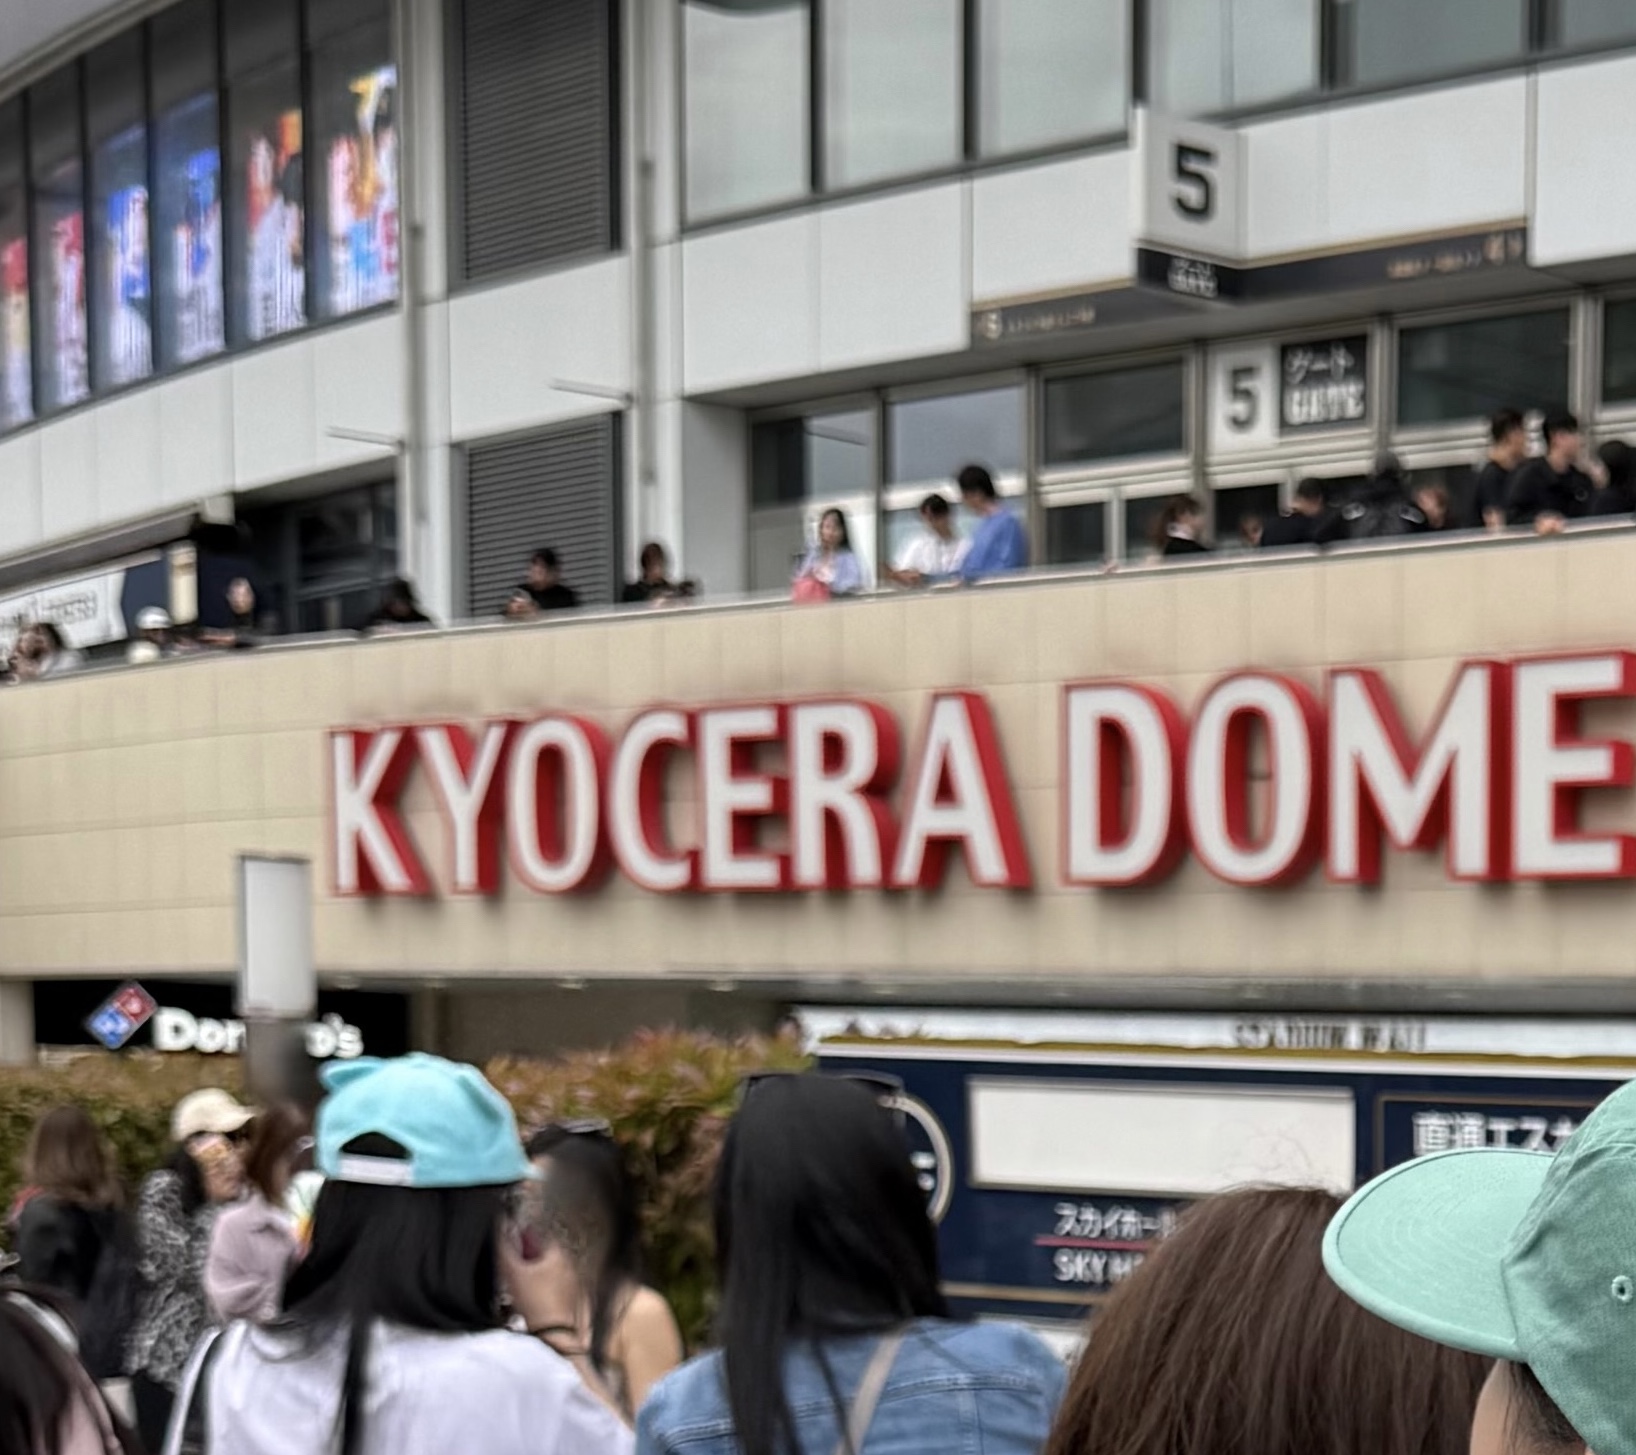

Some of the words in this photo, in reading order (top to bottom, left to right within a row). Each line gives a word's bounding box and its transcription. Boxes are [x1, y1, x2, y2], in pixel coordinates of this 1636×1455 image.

[1172, 143, 1216, 222] 5
[1227, 366, 1261, 432] 5
[330, 688, 1034, 896] KYOCERA
[154, 1006, 363, 1058] Doo's
